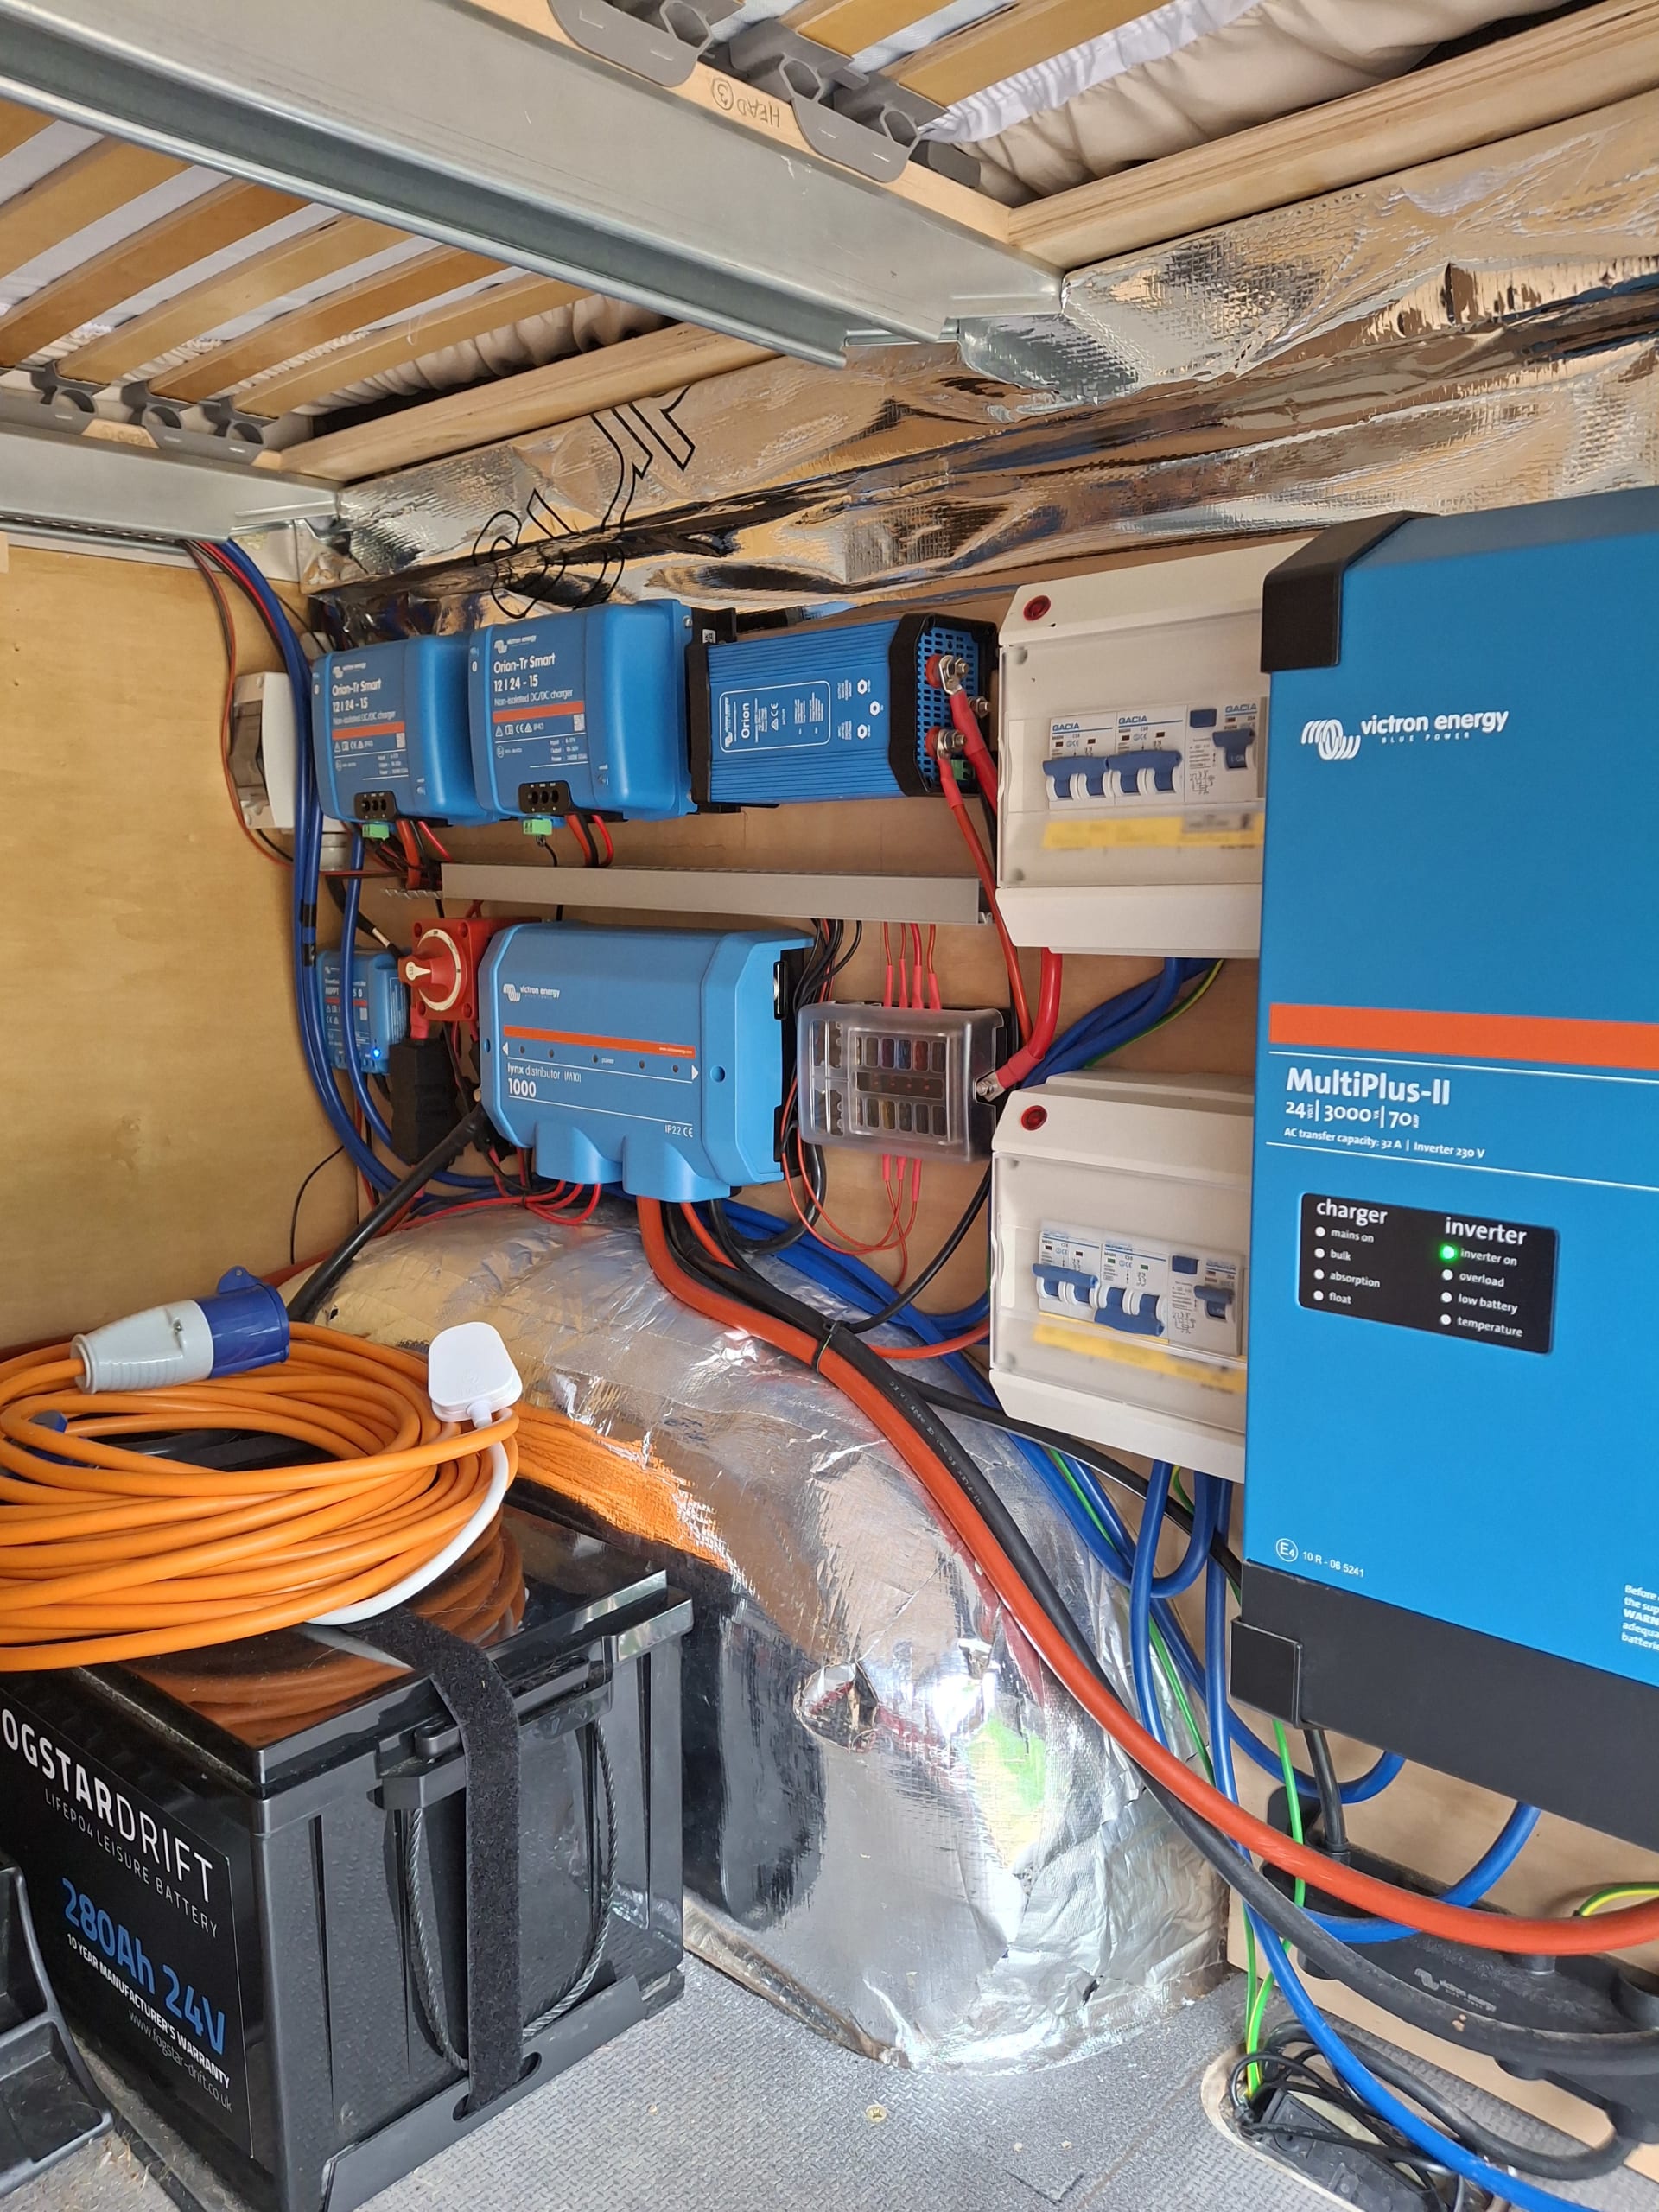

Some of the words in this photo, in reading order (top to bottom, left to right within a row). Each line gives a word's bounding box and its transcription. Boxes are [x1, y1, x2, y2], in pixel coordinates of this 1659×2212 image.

[737, 97, 779, 127] HEAD
[493, 657, 528, 673] Orion-Tr
[529, 652, 556, 668] Smart
[332, 680, 359, 696] Orion-Tr
[360, 678, 381, 692] Smart
[493, 679, 503, 692] 12
[510, 677, 520, 690] 24
[529, 675, 538, 687] 15
[345, 699, 354, 711] 24
[360, 697, 368, 709] 15
[530, 692, 548, 702] DC/DC
[550, 690, 574, 700] charger
[741, 702, 750, 739] Orion
[1361, 714, 1429, 734] victron
[1434, 710, 1510, 733] energy
[1425, 732, 1470, 741] POWER
[519, 985, 539, 994] victron
[540, 988, 560, 999] energy
[507, 1062, 524, 1075] lynx
[525, 1066, 561, 1080] distributor
[508, 1077, 537, 1098] 1000
[1286, 1066, 1451, 1106] MultiPlus-II
[1285, 1101, 1306, 1119] 24
[1323, 1104, 1372, 1122] 3000
[1389, 1111, 1412, 1129] 70
[664, 1124, 682, 1135] IP22
[1284, 1127, 1297, 1138] AC
[1299, 1128, 1336, 1141] transfer
[1337, 1133, 1379, 1148] capacity:
[1382, 1140, 1393, 1149] 32
[1394, 1139, 1402, 1149] A
[1414, 1141, 1454, 1155] Inverter
[1456, 1147, 1476, 1160] 230
[1476, 1148, 1485, 1159] V
[1316, 1198, 1389, 1226] charger
[1331, 1228, 1360, 1242] mains
[1360, 1233, 1375, 1243] on
[1445, 1217, 1527, 1245] inverter
[1330, 1249, 1351, 1262] bulk
[1460, 1248, 1502, 1265] inverter
[1503, 1255, 1517, 1267] on
[1329, 1269, 1381, 1288] absorption
[1459, 1271, 1505, 1288] overload
[1328, 1291, 1352, 1305] float
[1458, 1294, 1478, 1306] low
[1478, 1298, 1518, 1316] battery
[1456, 1315, 1523, 1338] temperature
[1303, 1551, 1313, 1562] 10
[1315, 1555, 1322, 1566] R
[1330, 1559, 1341, 1571] 06
[1343, 1563, 1364, 1578] 5241
[1624, 1584, 1657, 1601] Before
[1624, 1596, 1641, 1609] the
[45, 1788, 94, 1840] LIFEPO4
[97, 1829, 150, 1885] LEISURE
[156, 1876, 218, 1939] BATTERY
[62, 1877, 156, 1995] 280Ah
[162, 1963, 226, 2056] 24V
[67, 1933, 78, 1950] 10
[78, 1943, 99, 1971] YEAR
[99, 1961, 175, 2039] MANUFACTURER'S
[175, 2030, 230, 2090] WARRANTY
[129, 2010, 232, 2113] www.fogstar-drift.co.uk
